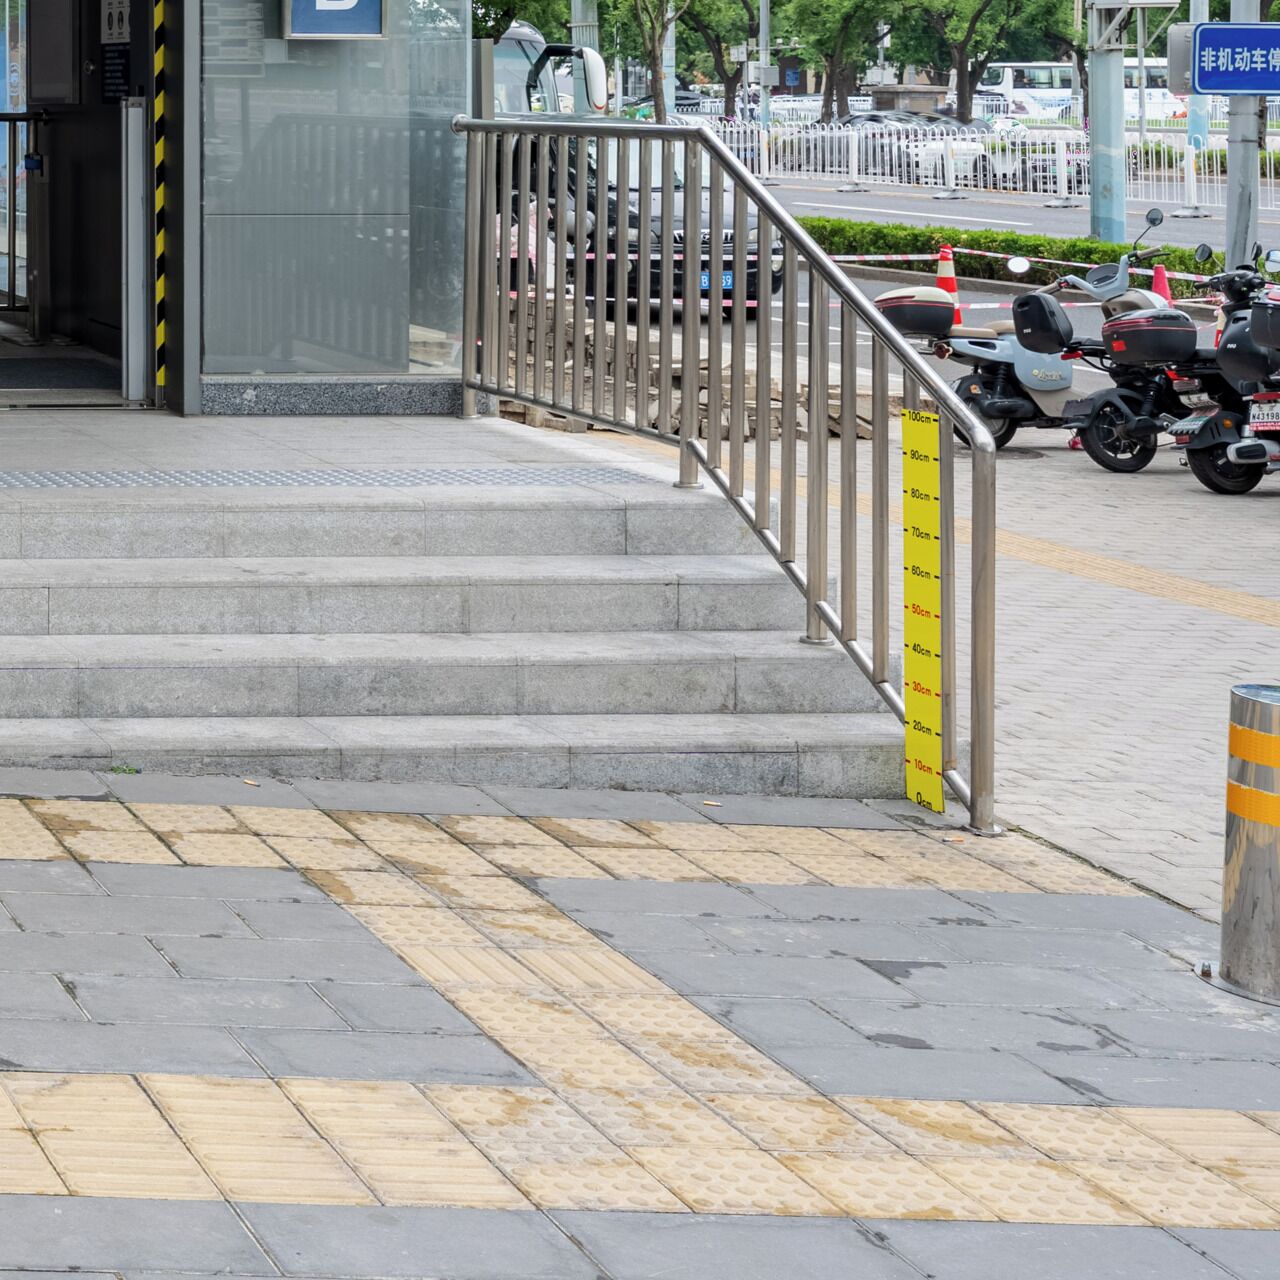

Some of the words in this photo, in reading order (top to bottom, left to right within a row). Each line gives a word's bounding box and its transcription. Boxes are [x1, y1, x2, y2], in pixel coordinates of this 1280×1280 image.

[908, 410, 932, 424] 100cm
[910, 449, 930, 463] 90cm
[911, 487, 931, 502] 80cm
[911, 526, 931, 541] 70cm
[911, 565, 931, 580] 60cm
[911, 603, 931, 619] 50cm
[912, 642, 932, 658] 40cm
[912, 681, 932, 697] 30cm
[913, 720, 932, 736] 20cm
[914, 758, 933, 776] 10cm
